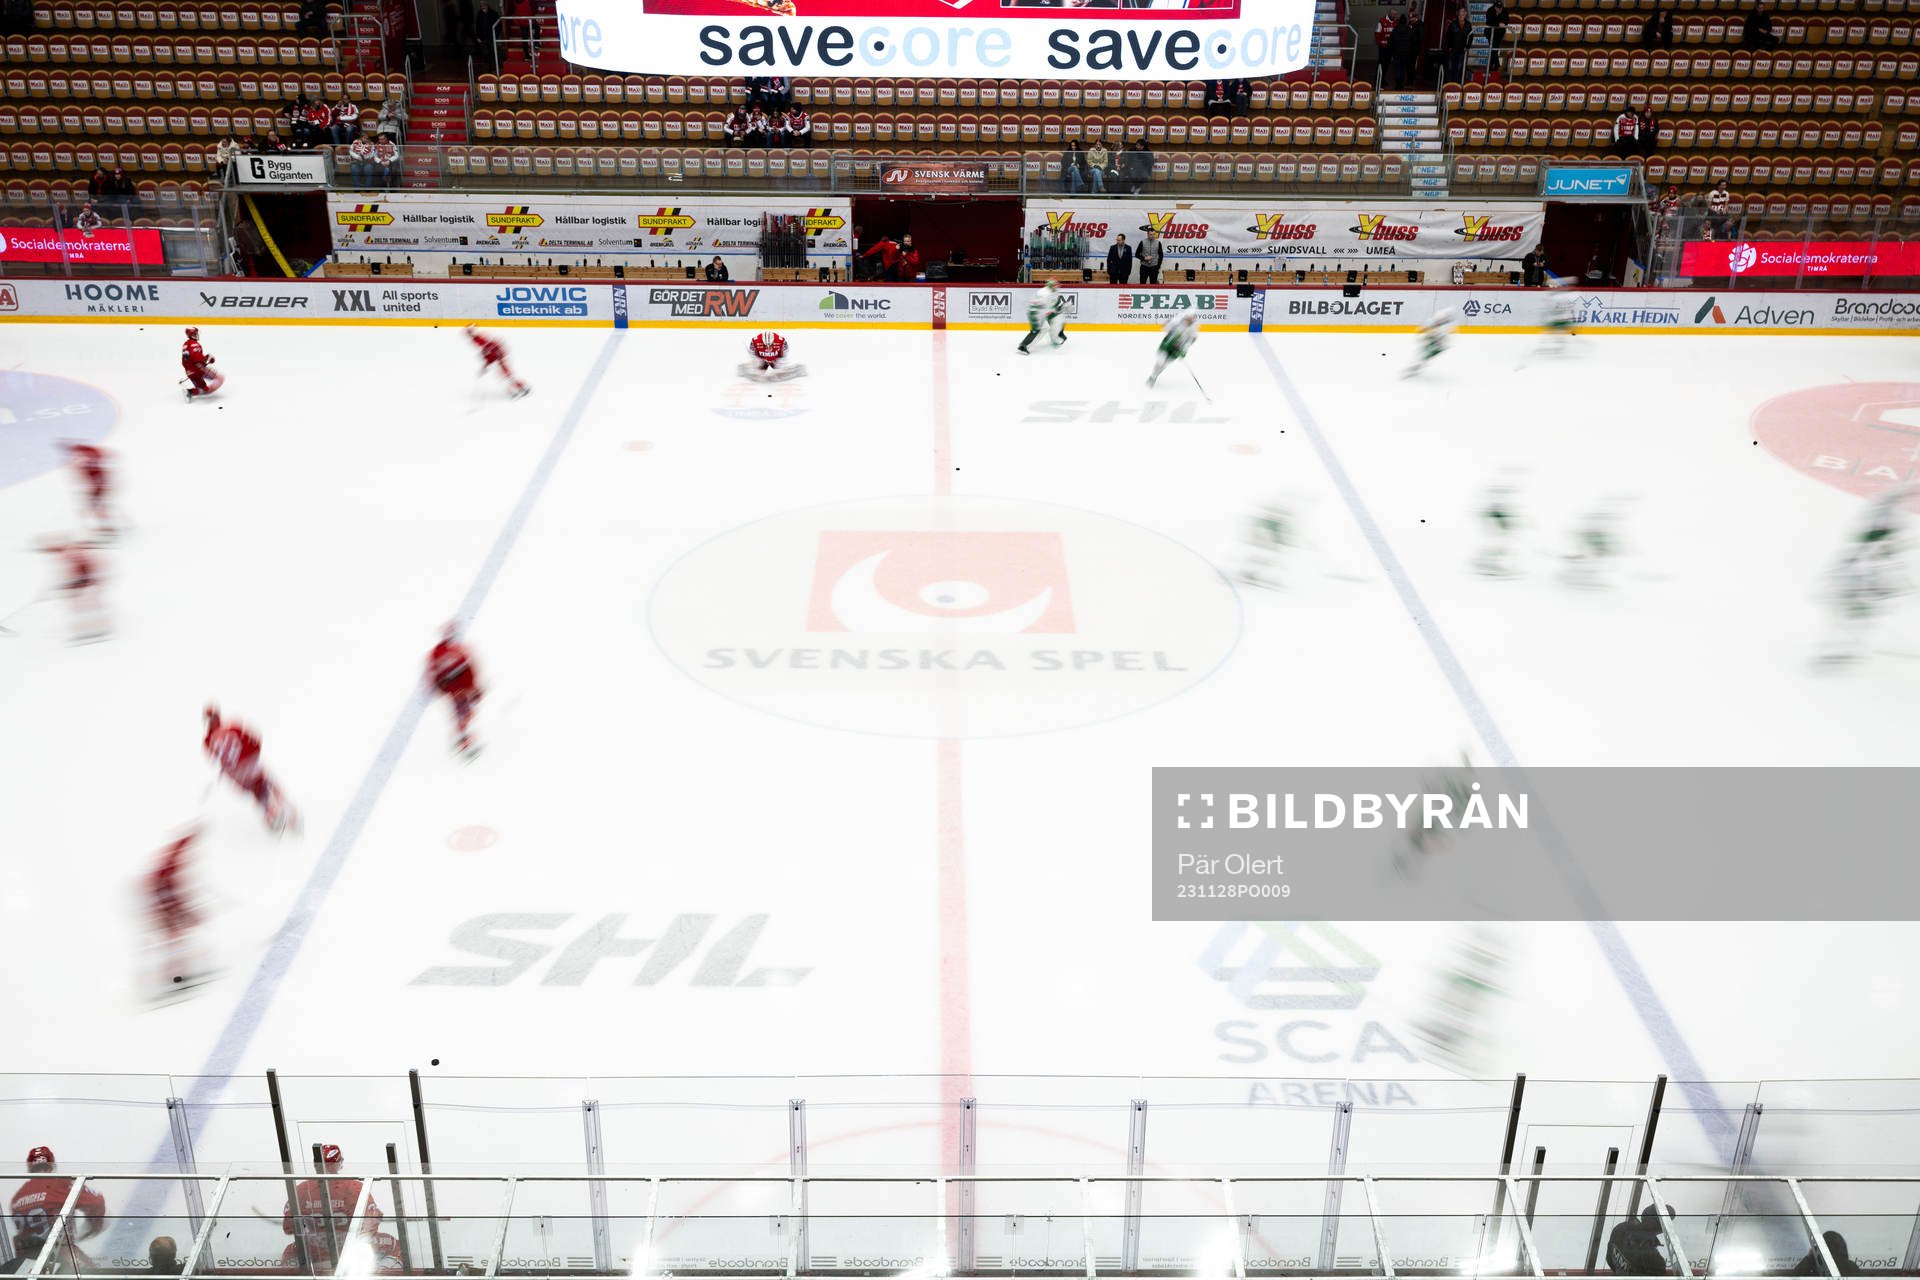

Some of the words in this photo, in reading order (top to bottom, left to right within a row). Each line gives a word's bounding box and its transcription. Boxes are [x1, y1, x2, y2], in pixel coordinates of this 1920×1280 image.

[700, 25, 1011, 67] savecore
[1047, 22, 1301, 71] savecore
[268, 160, 292, 171] Bygg
[269, 171, 313, 181] Giganten
[914, 170, 950, 178] SVENSK
[953, 168, 985, 178] VÄRME
[1548, 179, 1617, 190] JUNET
[340, 215, 386, 223] SUNDFRAKT
[403, 213, 437, 223] Hållbar
[440, 214, 475, 225] logistik
[491, 216, 536, 224] SUNDFRAKT
[555, 215, 590, 225] Hållbar
[592, 216, 627, 226] logistik
[707, 217, 742, 227] Hållbar
[744, 218, 763, 228] logi
[11, 238, 131, 252] Socialdemokraterna
[424, 236, 459, 244] Solventum
[598, 238, 633, 246] Solventum
[1166, 245, 1230, 254] STOCKHOLM
[1267, 245, 1327, 255] SUNDSVALL
[1366, 245, 1396, 255] UMEÅ
[1761, 251, 1878, 264] Socialdemokraterna
[65, 284, 160, 301] HOOME
[383, 290, 398, 301] All
[400, 291, 439, 303] sports
[496, 287, 587, 302] JOWIC
[653, 290, 678, 302] GÖR
[680, 291, 705, 302] DET
[332, 289, 376, 312] XXL
[614, 288, 627, 317] NRS
[704, 290, 757, 315] RW
[851, 299, 891, 310] NHC
[933, 290, 945, 319] NRS
[972, 295, 1009, 305] MM
[1130, 294, 1217, 310] PEAB
[1251, 291, 1264, 320] NRS
[87, 303, 144, 313] MÄKLERI
[383, 302, 421, 313] united
[502, 303, 562, 315] elteknik
[564, 303, 583, 315] ab
[675, 303, 703, 314] MED
[1289, 300, 1404, 315] BILBOLAGET
[1483, 303, 1512, 314] SCA
[1590, 310, 1629, 324] KARL
[1632, 310, 1679, 324] HEDIN
[1735, 305, 1815, 325] Adven
[1020, 401, 1231, 424] SHL
[704, 648, 1007, 671] SVENSKA
[1032, 649, 1188, 672] SPEL
[407, 912, 816, 987] SHL
[1213, 1020, 1421, 1064] SCA
[1248, 1081, 1417, 1106] ARENA
